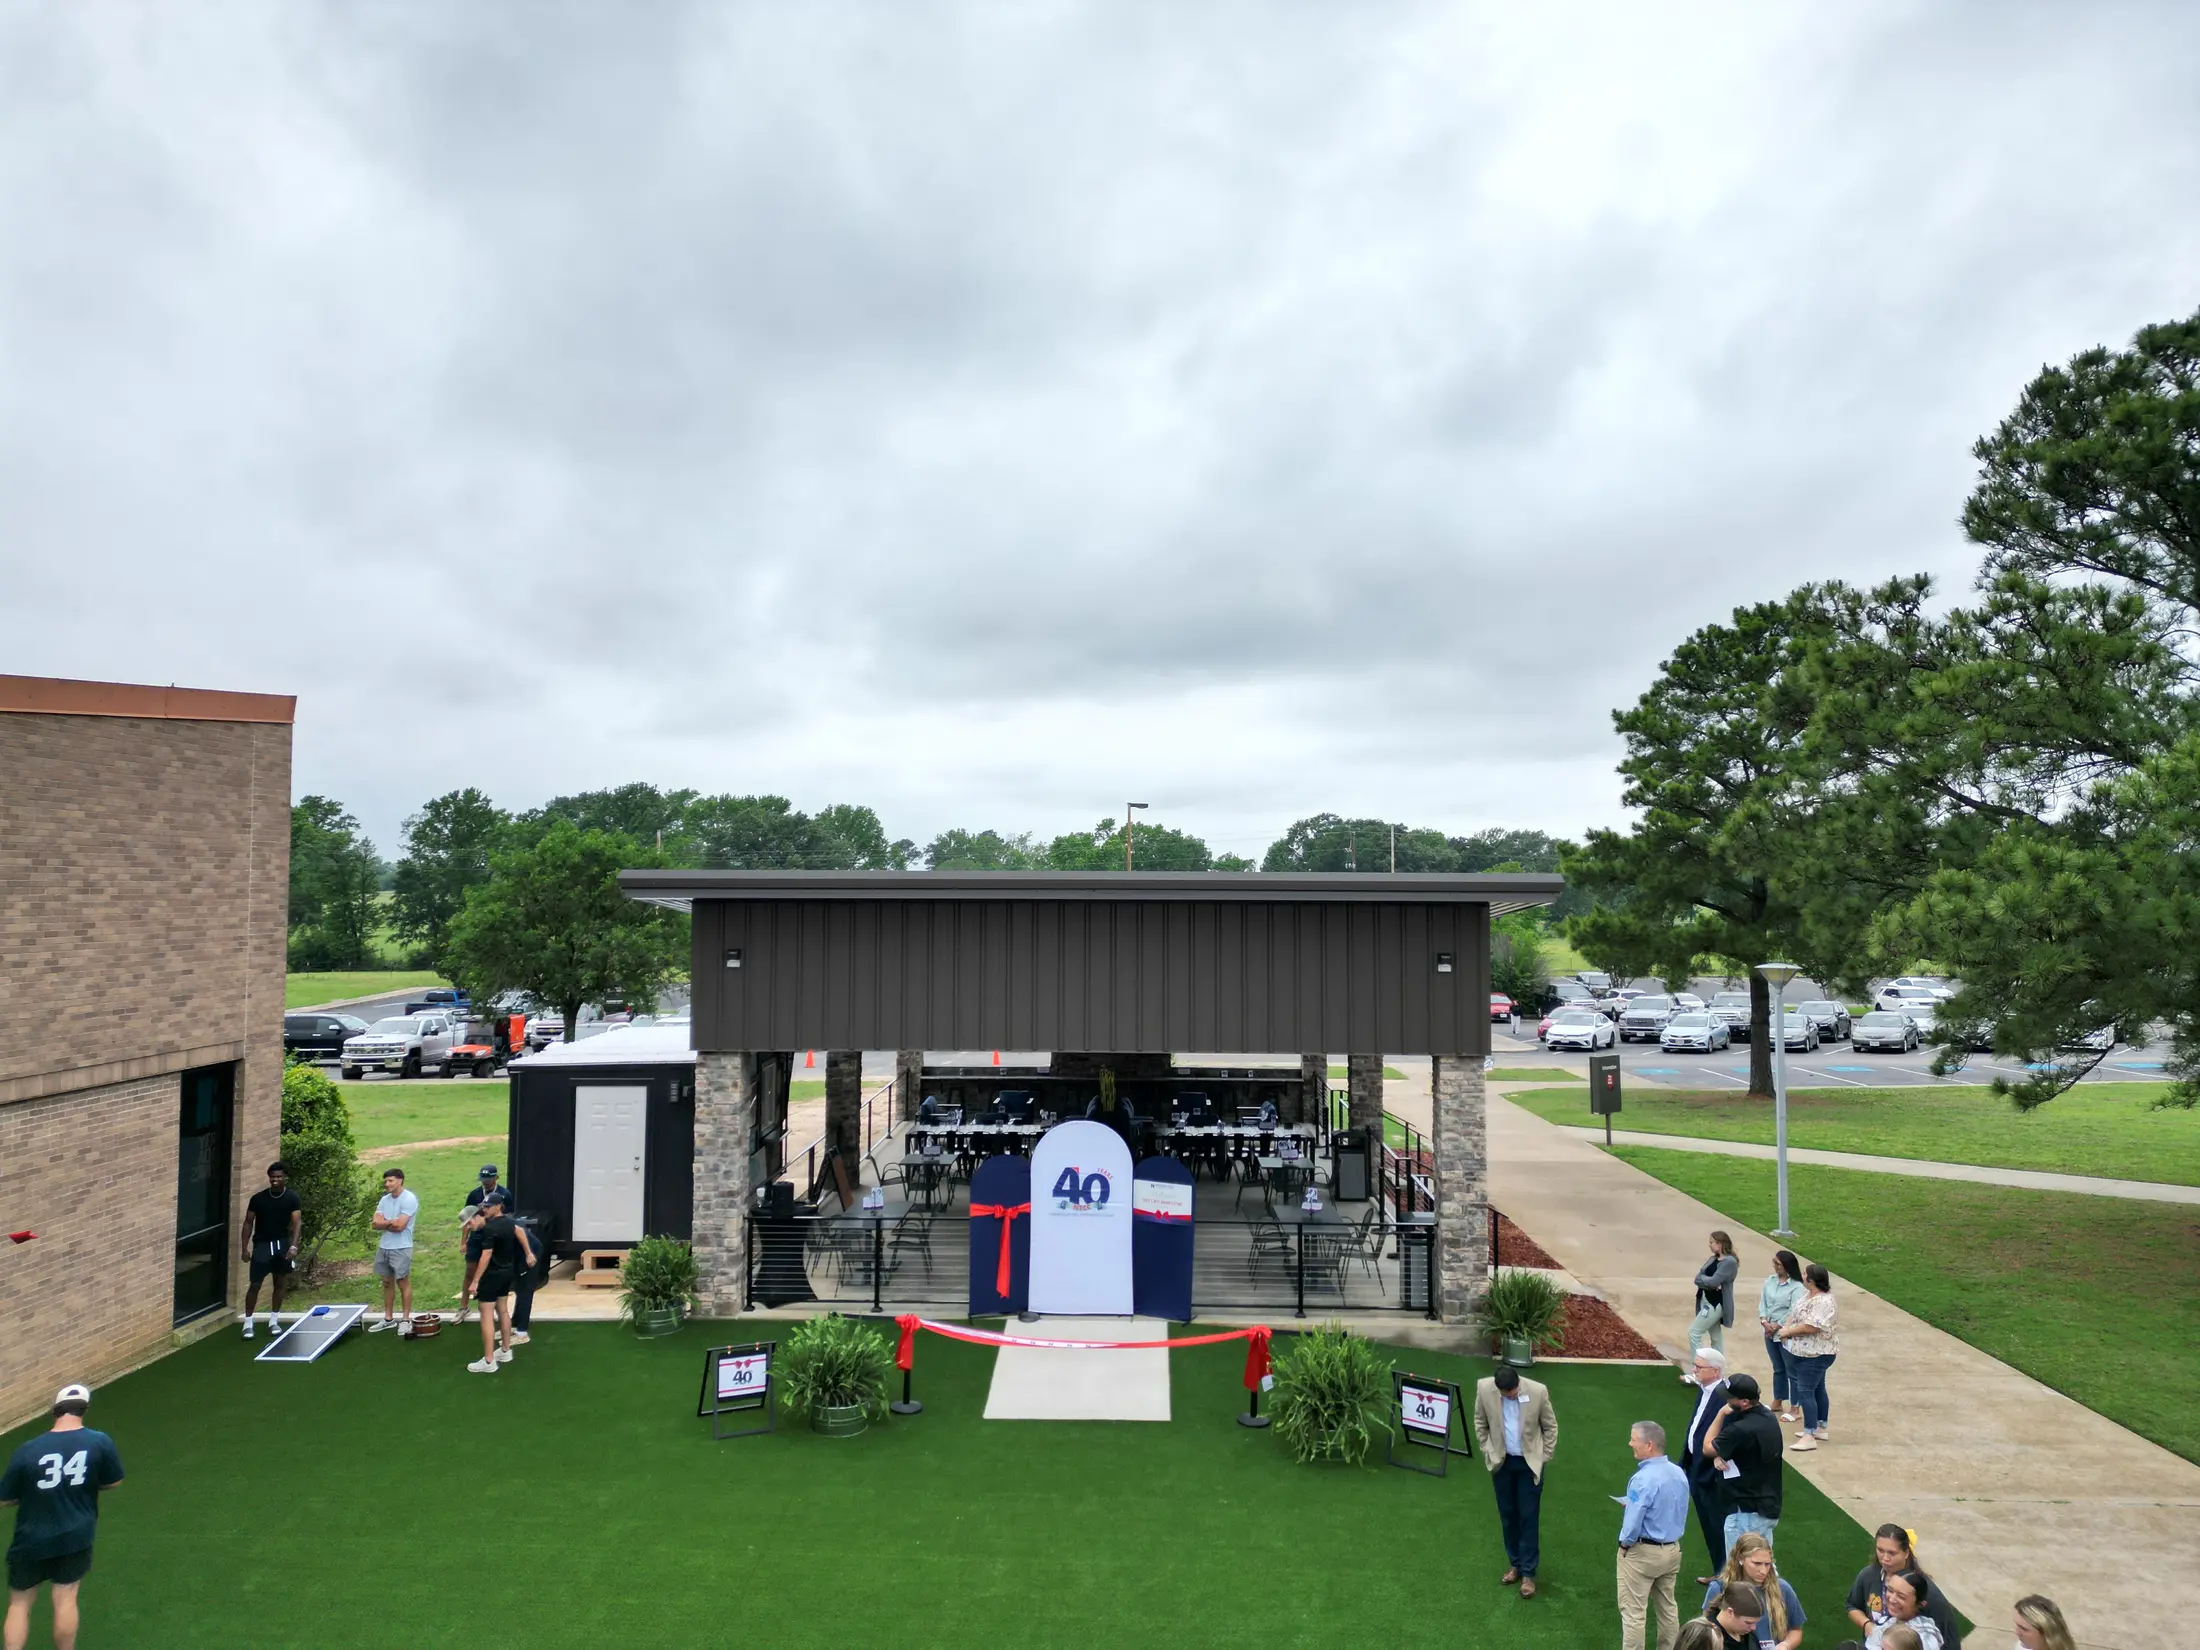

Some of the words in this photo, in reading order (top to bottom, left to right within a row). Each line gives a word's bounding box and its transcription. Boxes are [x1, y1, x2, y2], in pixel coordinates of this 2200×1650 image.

[1052, 1167, 1110, 1204] 40
[733, 1370, 753, 1383] 40
[1416, 1404, 1435, 1420] 40
[37, 1450, 88, 1489] 34
